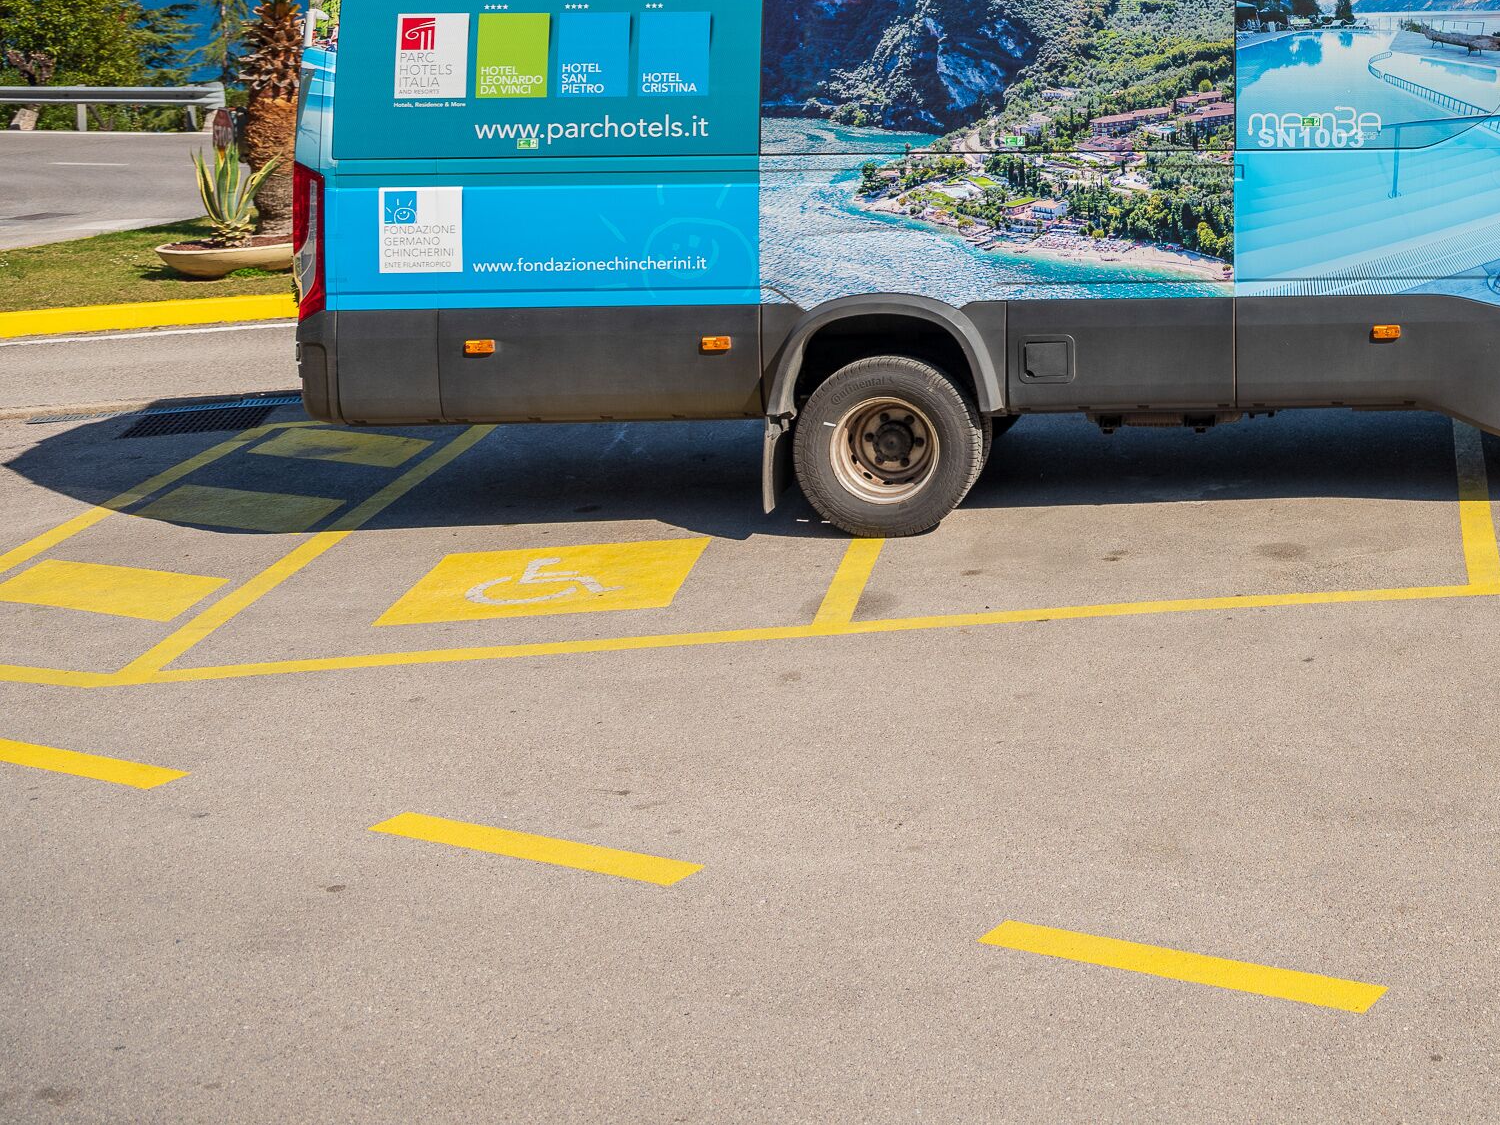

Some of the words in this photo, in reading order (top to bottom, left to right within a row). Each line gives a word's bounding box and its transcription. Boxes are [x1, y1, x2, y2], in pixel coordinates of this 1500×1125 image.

[400, 52, 434, 63] PARC
[399, 64, 452, 75] HOTELS
[481, 66, 518, 75] HOTEL
[562, 63, 602, 73] HOTEL
[399, 77, 440, 88] ITALIA
[480, 75, 543, 85] LEONARDO
[561, 73, 587, 83] SAN
[642, 73, 682, 82] HOTEL
[480, 85, 497, 95] DA
[500, 85, 531, 94] VINCI
[561, 84, 604, 94] PIETRO
[642, 82, 697, 93] CRISTINA
[475, 114, 709, 145] www.parchotels.it
[1258, 129, 1365, 148] SN1003
[384, 225, 456, 235] FONDAZIONE
[384, 236, 441, 246] GERMANO
[384, 248, 454, 257] CHINCHERINI
[472, 256, 707, 273] www.fondazionechincherini.it
[831, 375, 886, 405] Continental
